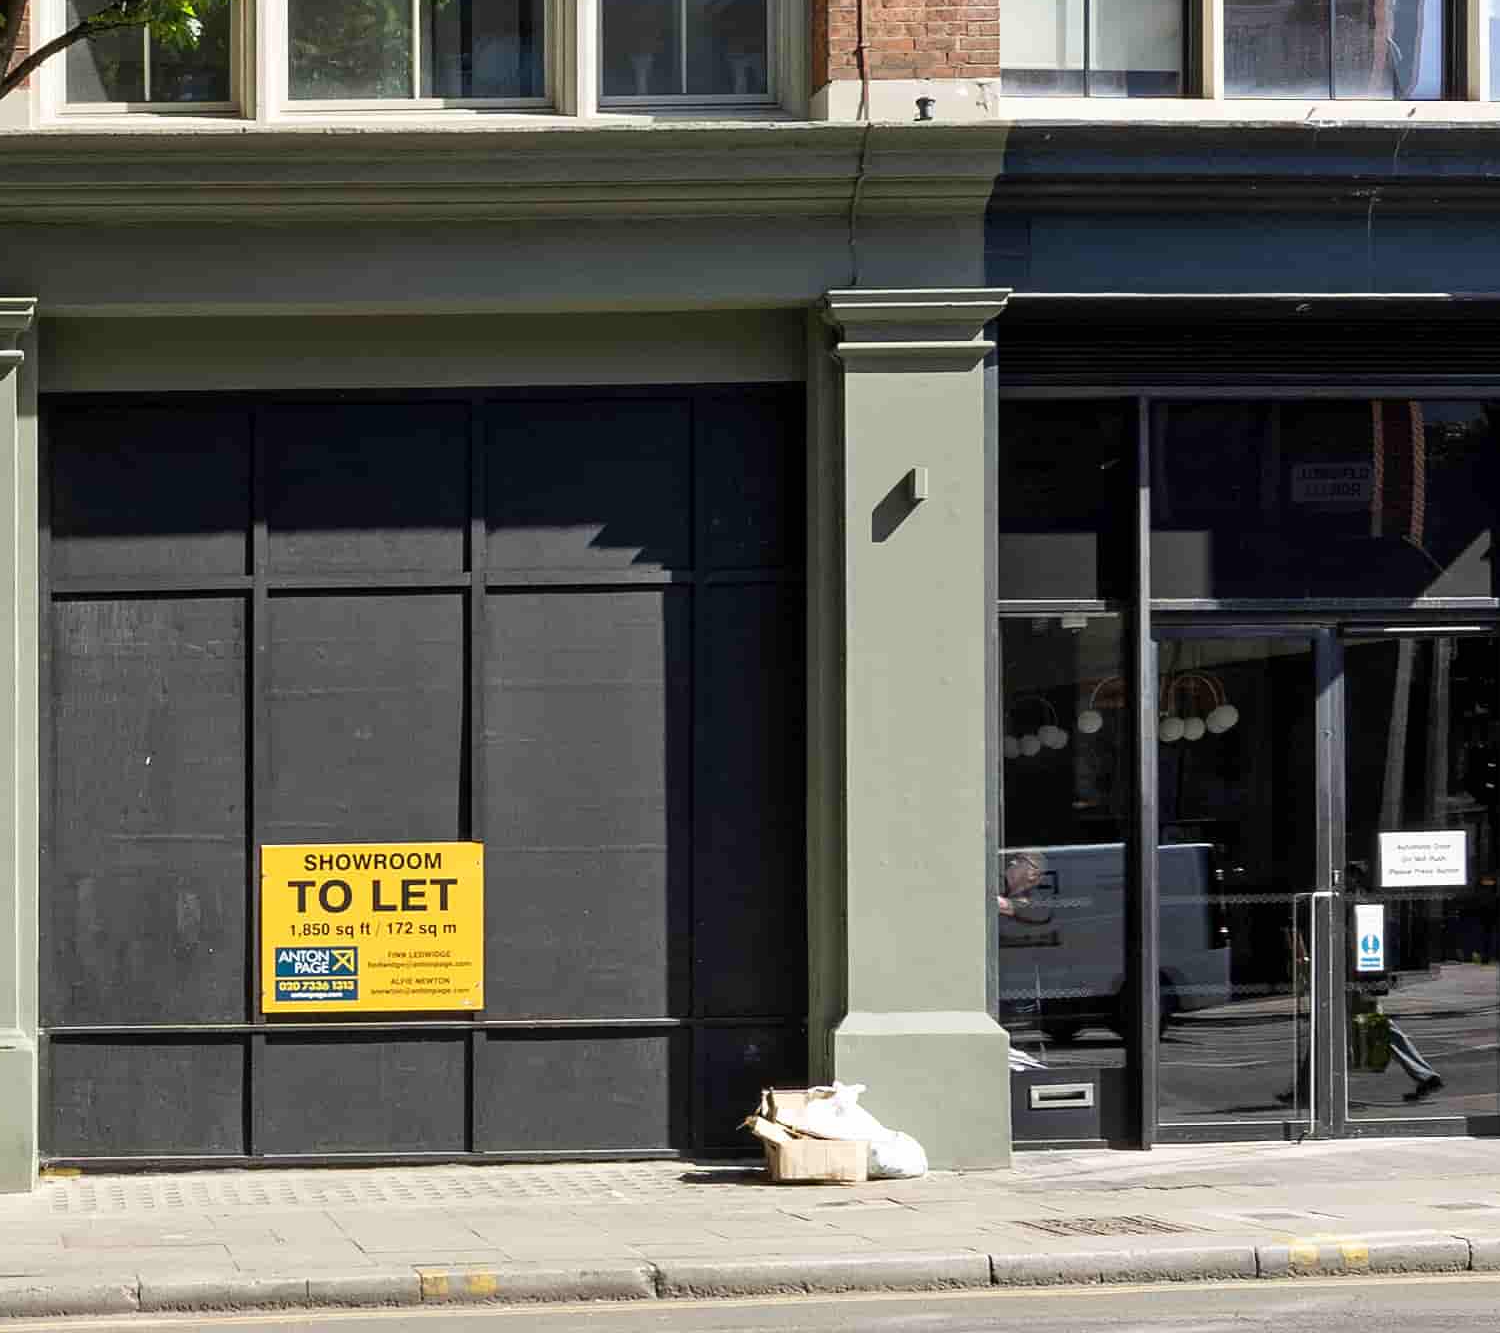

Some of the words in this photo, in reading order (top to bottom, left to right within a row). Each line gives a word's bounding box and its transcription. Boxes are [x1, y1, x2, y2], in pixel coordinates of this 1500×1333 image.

[304, 852, 442, 871] SHOWROOM
[288, 879, 353, 913] TO
[371, 878, 458, 912] LET
[290, 923, 330, 937] 1,850
[335, 924, 354, 939] sq
[360, 922, 371, 936] ft
[387, 922, 413, 935] 172
[418, 923, 437, 938] sq
[442, 922, 457, 934] m
[278, 949, 330, 963] ANTON
[294, 962, 330, 975] PAGE
